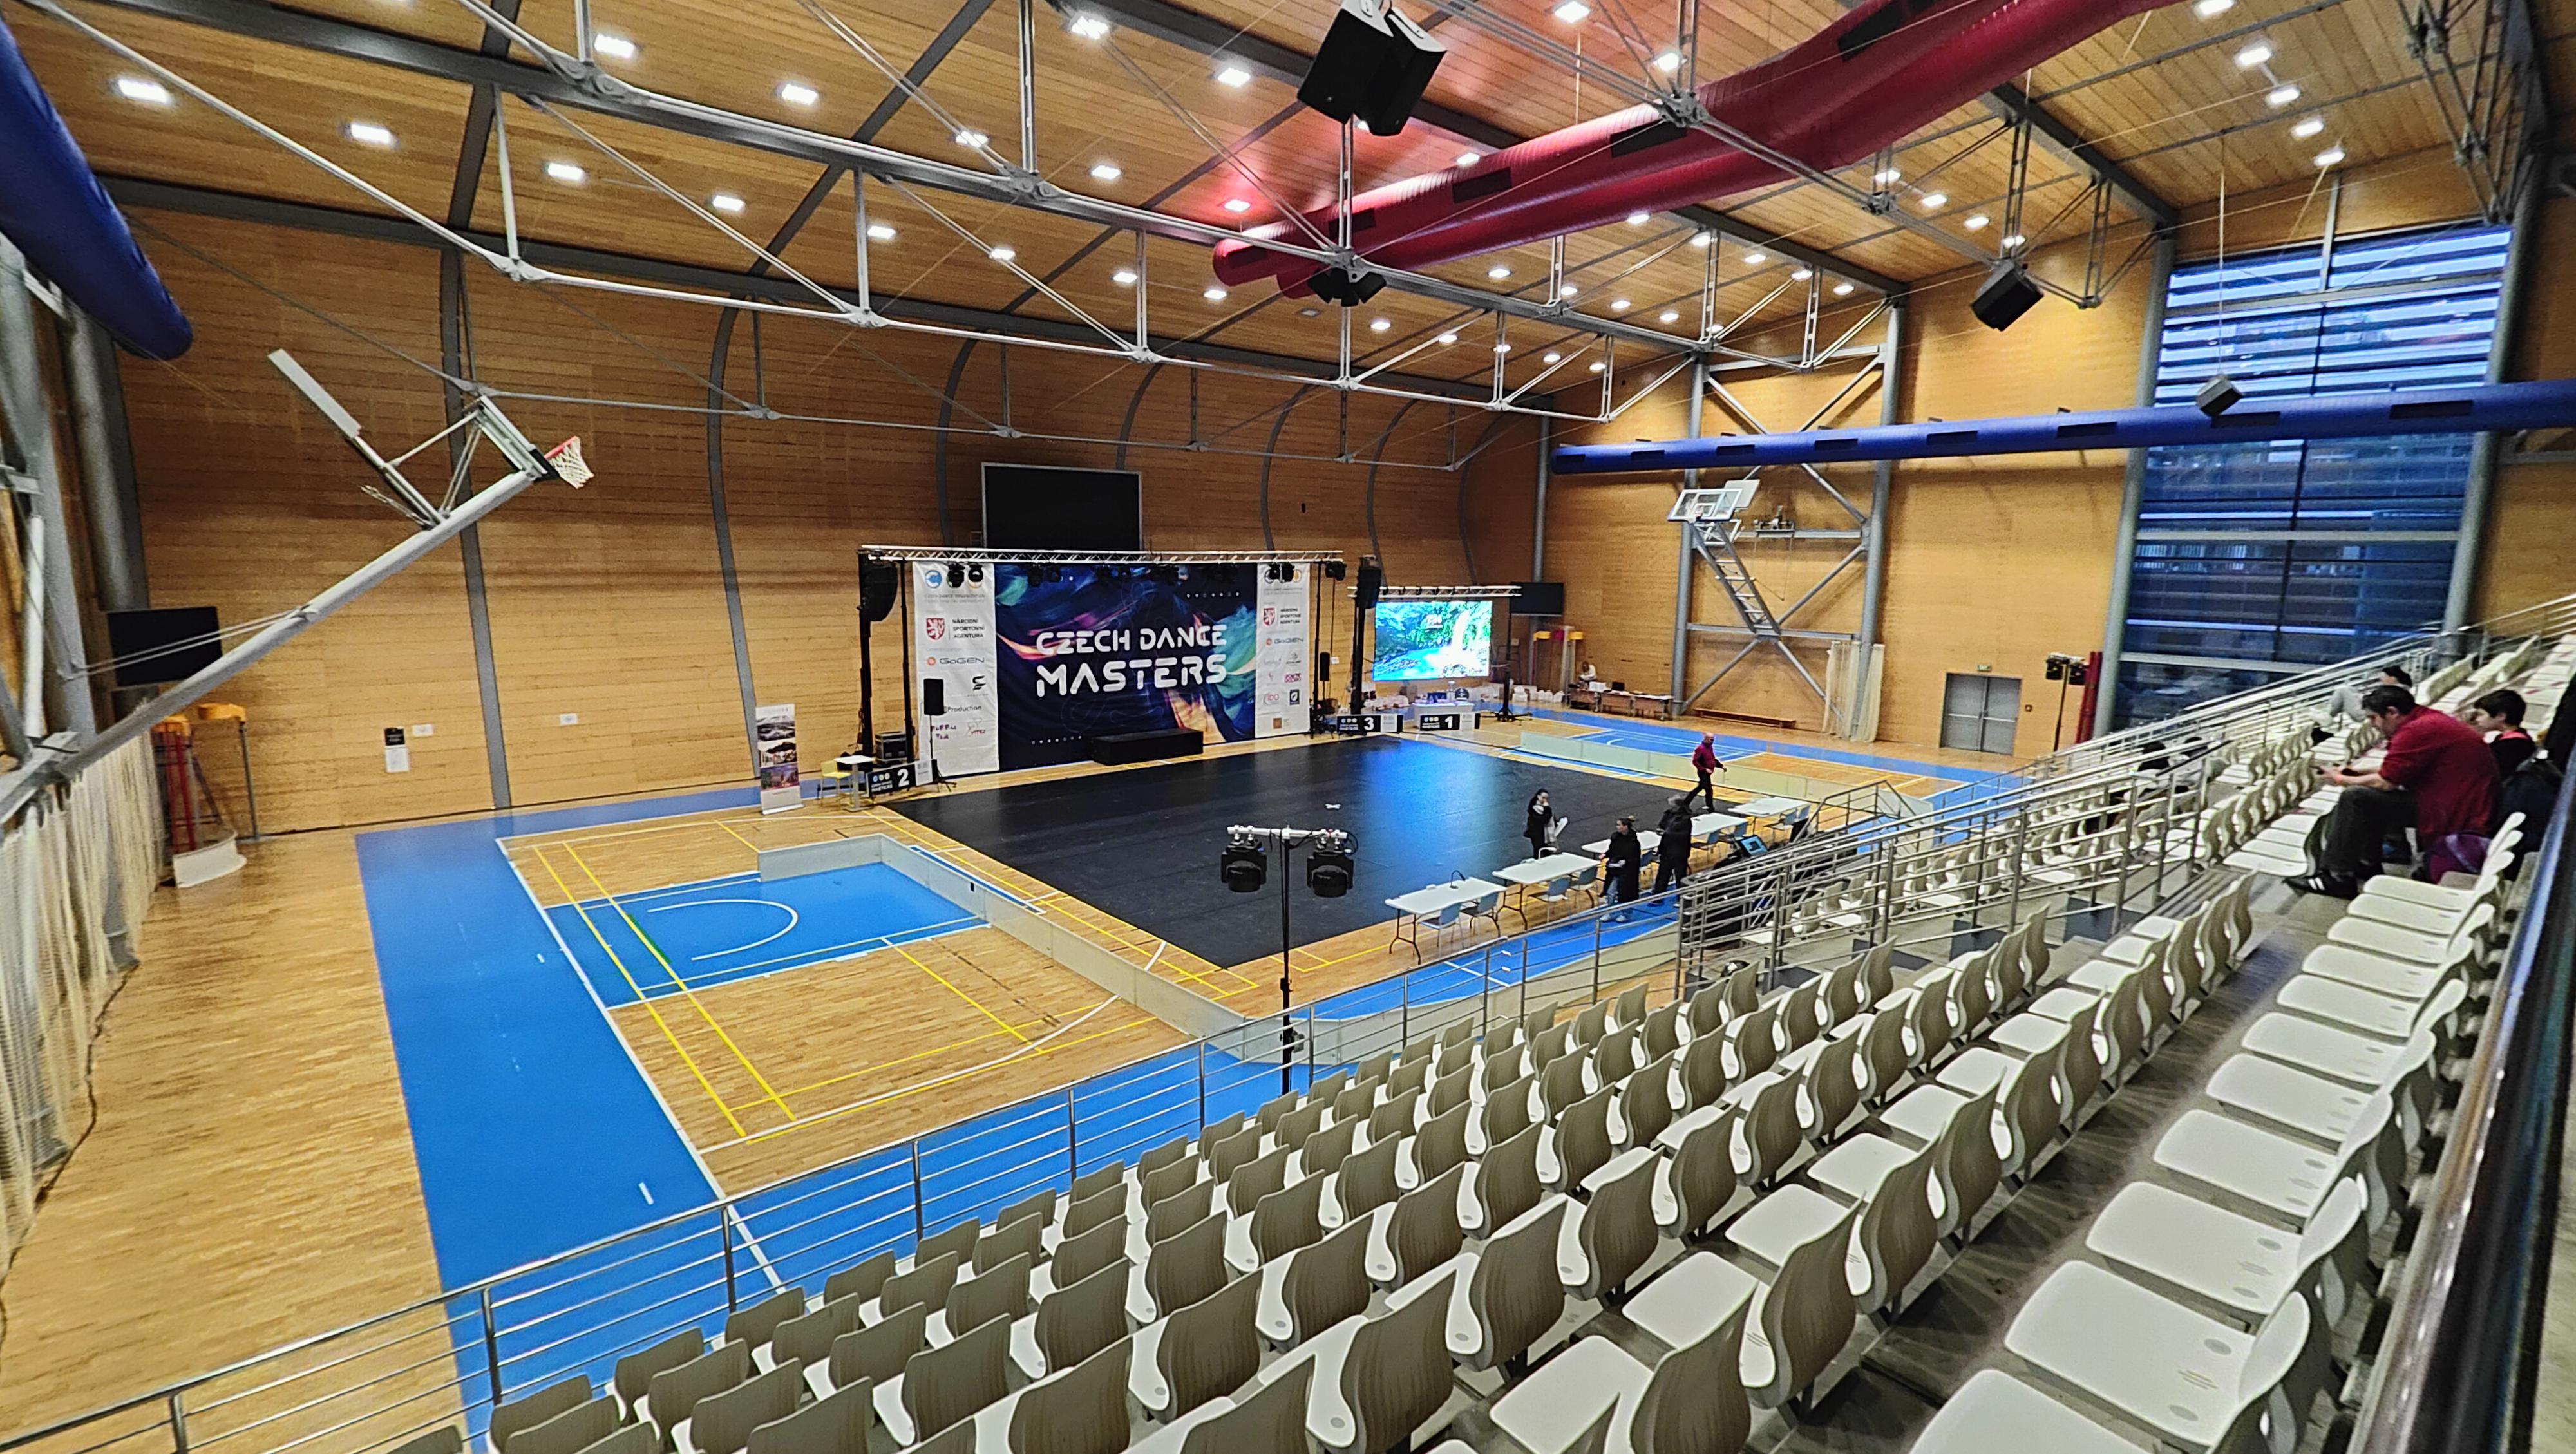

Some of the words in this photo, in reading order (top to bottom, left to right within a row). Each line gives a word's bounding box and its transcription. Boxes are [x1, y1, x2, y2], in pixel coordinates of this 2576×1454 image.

[1036, 628, 1130, 655] CZECH
[1139, 623, 1227, 650] DANCE
[1036, 653, 1227, 697] MASTERS
[1363, 717, 1375, 731] 3
[1444, 715, 1454, 728] 1
[897, 768, 910, 788] 2
